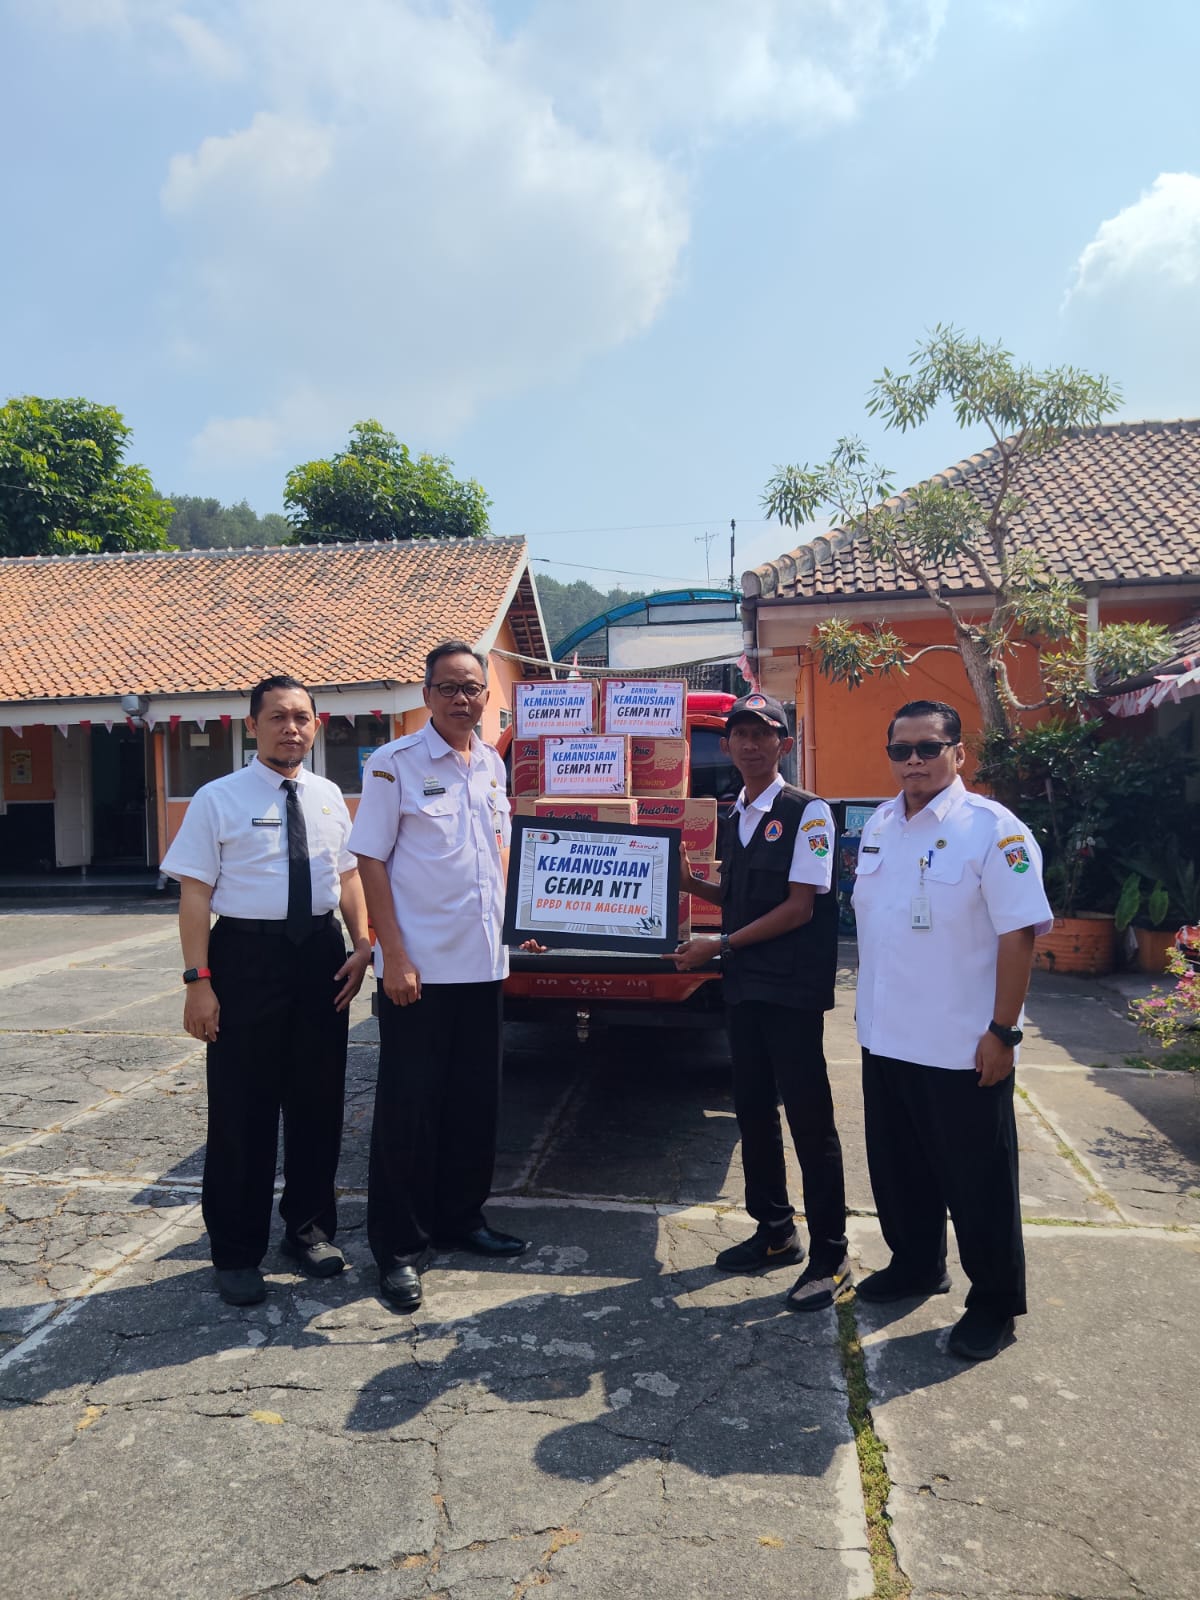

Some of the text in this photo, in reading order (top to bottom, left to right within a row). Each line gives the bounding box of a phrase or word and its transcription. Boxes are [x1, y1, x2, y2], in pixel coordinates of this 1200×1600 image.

[631, 687, 658, 695] BANTUAN
[524, 697, 586, 707] KEMANUSIAAN
[613, 695, 676, 706] KEMANUSIAAN
[528, 708, 581, 719] GEMPA NTT
[617, 706, 671, 718] GEMPA NTT
[552, 751, 617, 762] KEMANUSIAAN
[557, 763, 613, 775] GEMPA NTT
[570, 843, 618, 857] BANTUAN
[537, 855, 651, 878] KEMANUSIAAN
[545, 876, 642, 900] GEMPA NTT
[536, 898, 649, 915] BPBD KOTA MAGELANG
